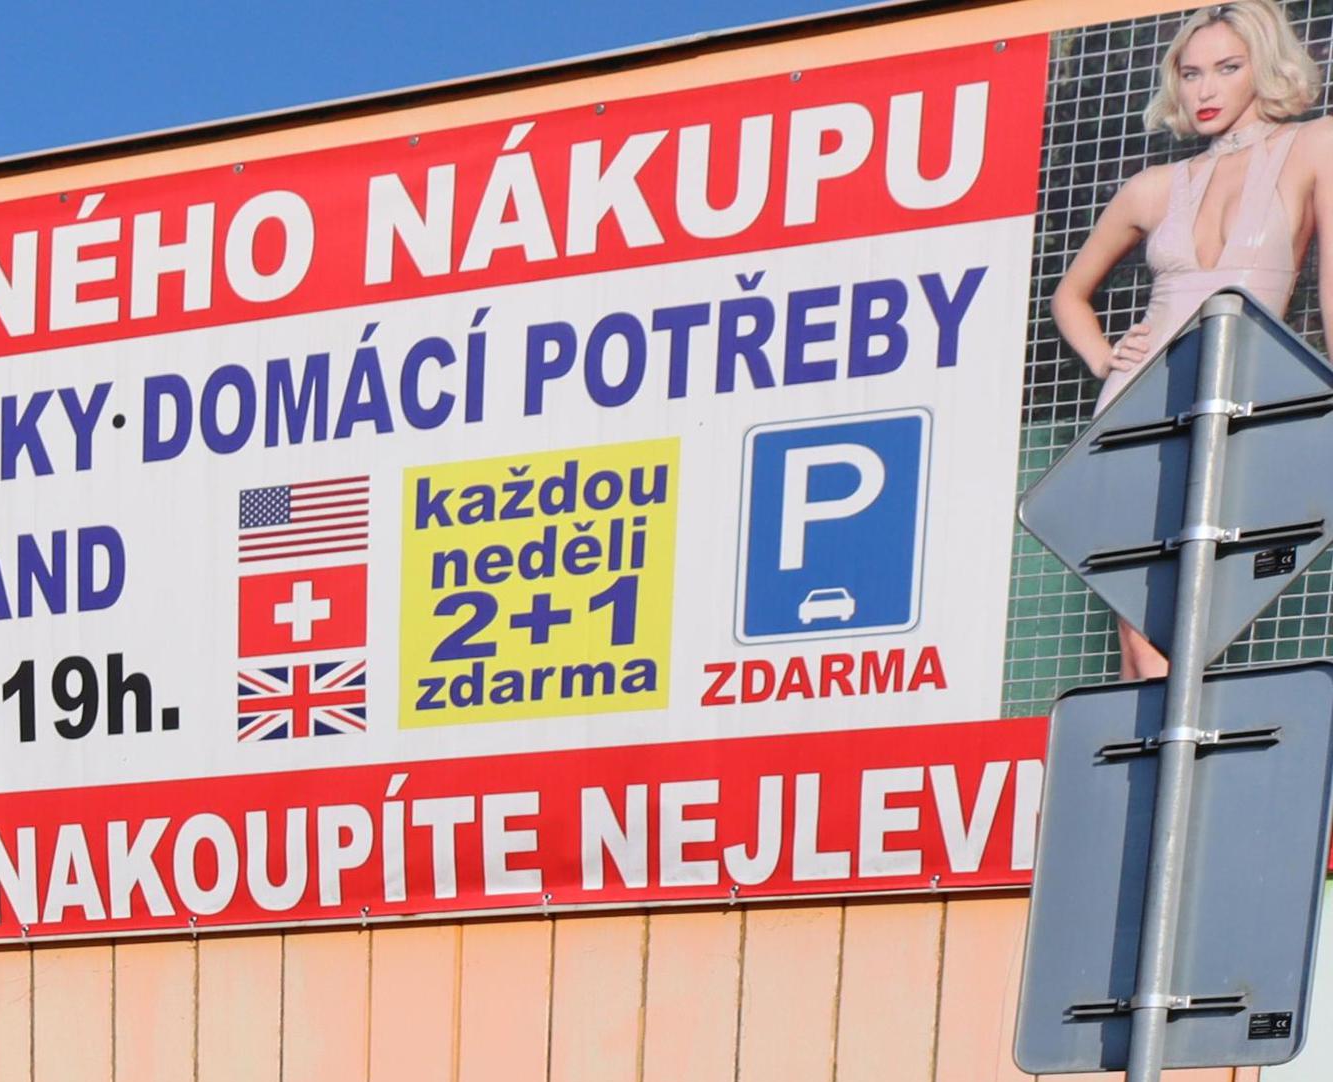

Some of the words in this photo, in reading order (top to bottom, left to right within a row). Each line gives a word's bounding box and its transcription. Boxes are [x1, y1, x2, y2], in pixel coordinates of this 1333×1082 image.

[364, 81, 989, 286] NÁKUPU
[523, 267, 988, 417] POTŘEBY
[414, 460, 668, 531] každou
[778, 442, 886, 571] P
[431, 516, 646, 589] neděli
[431, 575, 639, 662] 2+1
[415, 658, 657, 711] zdarma
[700, 646, 947, 707] ZDARMA
